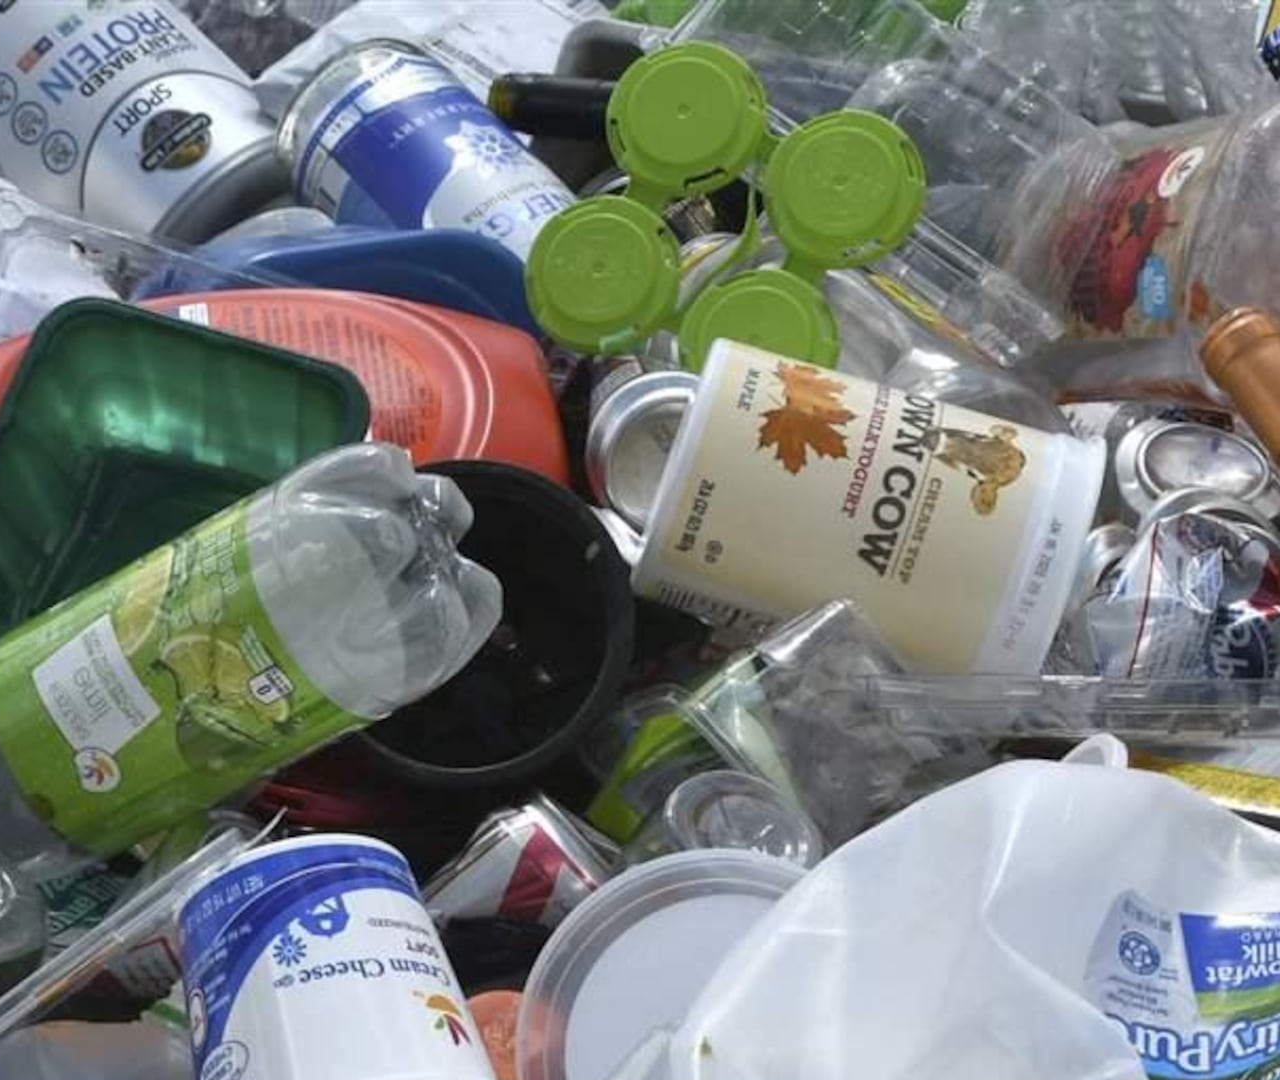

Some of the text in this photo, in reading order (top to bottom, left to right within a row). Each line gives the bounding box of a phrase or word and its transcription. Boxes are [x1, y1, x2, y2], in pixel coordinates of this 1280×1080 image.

[40, 7, 176, 105] PROTEIN
[79, 29, 189, 98] PLANT-BASED
[116, 82, 172, 135] SPORT
[735, 367, 762, 412] MAPLE
[839, 441, 878, 522] YOGURT
[854, 462, 915, 578] COW
[896, 475, 945, 588] CREAM TOP
[299, 958, 451, 986] Cream Cheese
